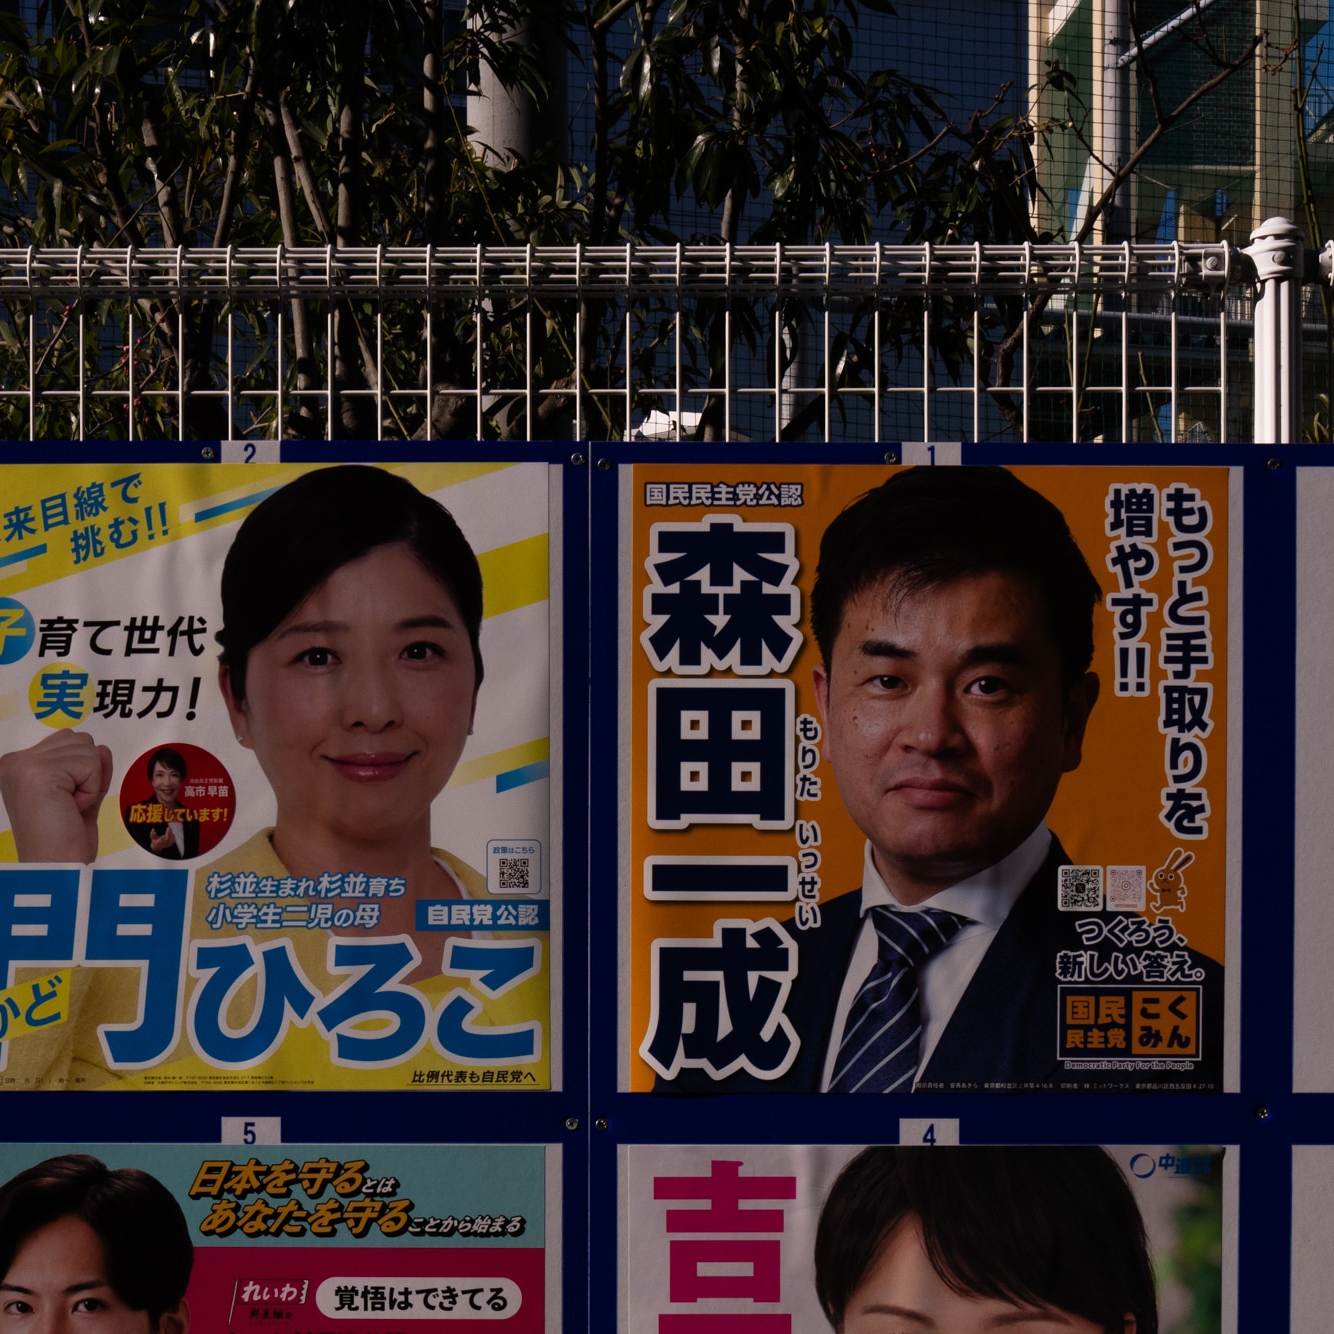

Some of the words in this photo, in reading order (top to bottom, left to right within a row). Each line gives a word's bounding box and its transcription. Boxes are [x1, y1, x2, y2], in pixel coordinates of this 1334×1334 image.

[243, 443, 257, 463] 2
[927, 445, 935, 465] 1
[644, 482, 804, 507] 国民民主党公認
[1161, 484, 1213, 839] もっと手取りを
[797, 715, 821, 801] もりた
[643, 517, 799, 1077] 森田一成
[206, 871, 407, 900] 杉並生まれ杉並育ち
[795, 820, 821, 929] いっせい
[206, 902, 381, 930] 小学生二児の母
[426, 904, 540, 927] 自民党公認
[411, 1069, 538, 1085] 比例代表も自民党へ
[1064, 1061, 1111, 1070] Democratic
[1113, 1061, 1135, 1071] Party
[1136, 1061, 1151, 1070] For
[1151, 1061, 1165, 1070] the
[1166, 1061, 1195, 1071] People
[244, 1122, 256, 1145] 5
[922, 1123, 936, 1146] 4
[188, 1157, 397, 1198] 日本を守るとは
[198, 1197, 525, 1237] あなたを守ることから始まる
[240, 1280, 299, 1303] れいわ
[334, 1286, 508, 1312] 覚悟はできてる
